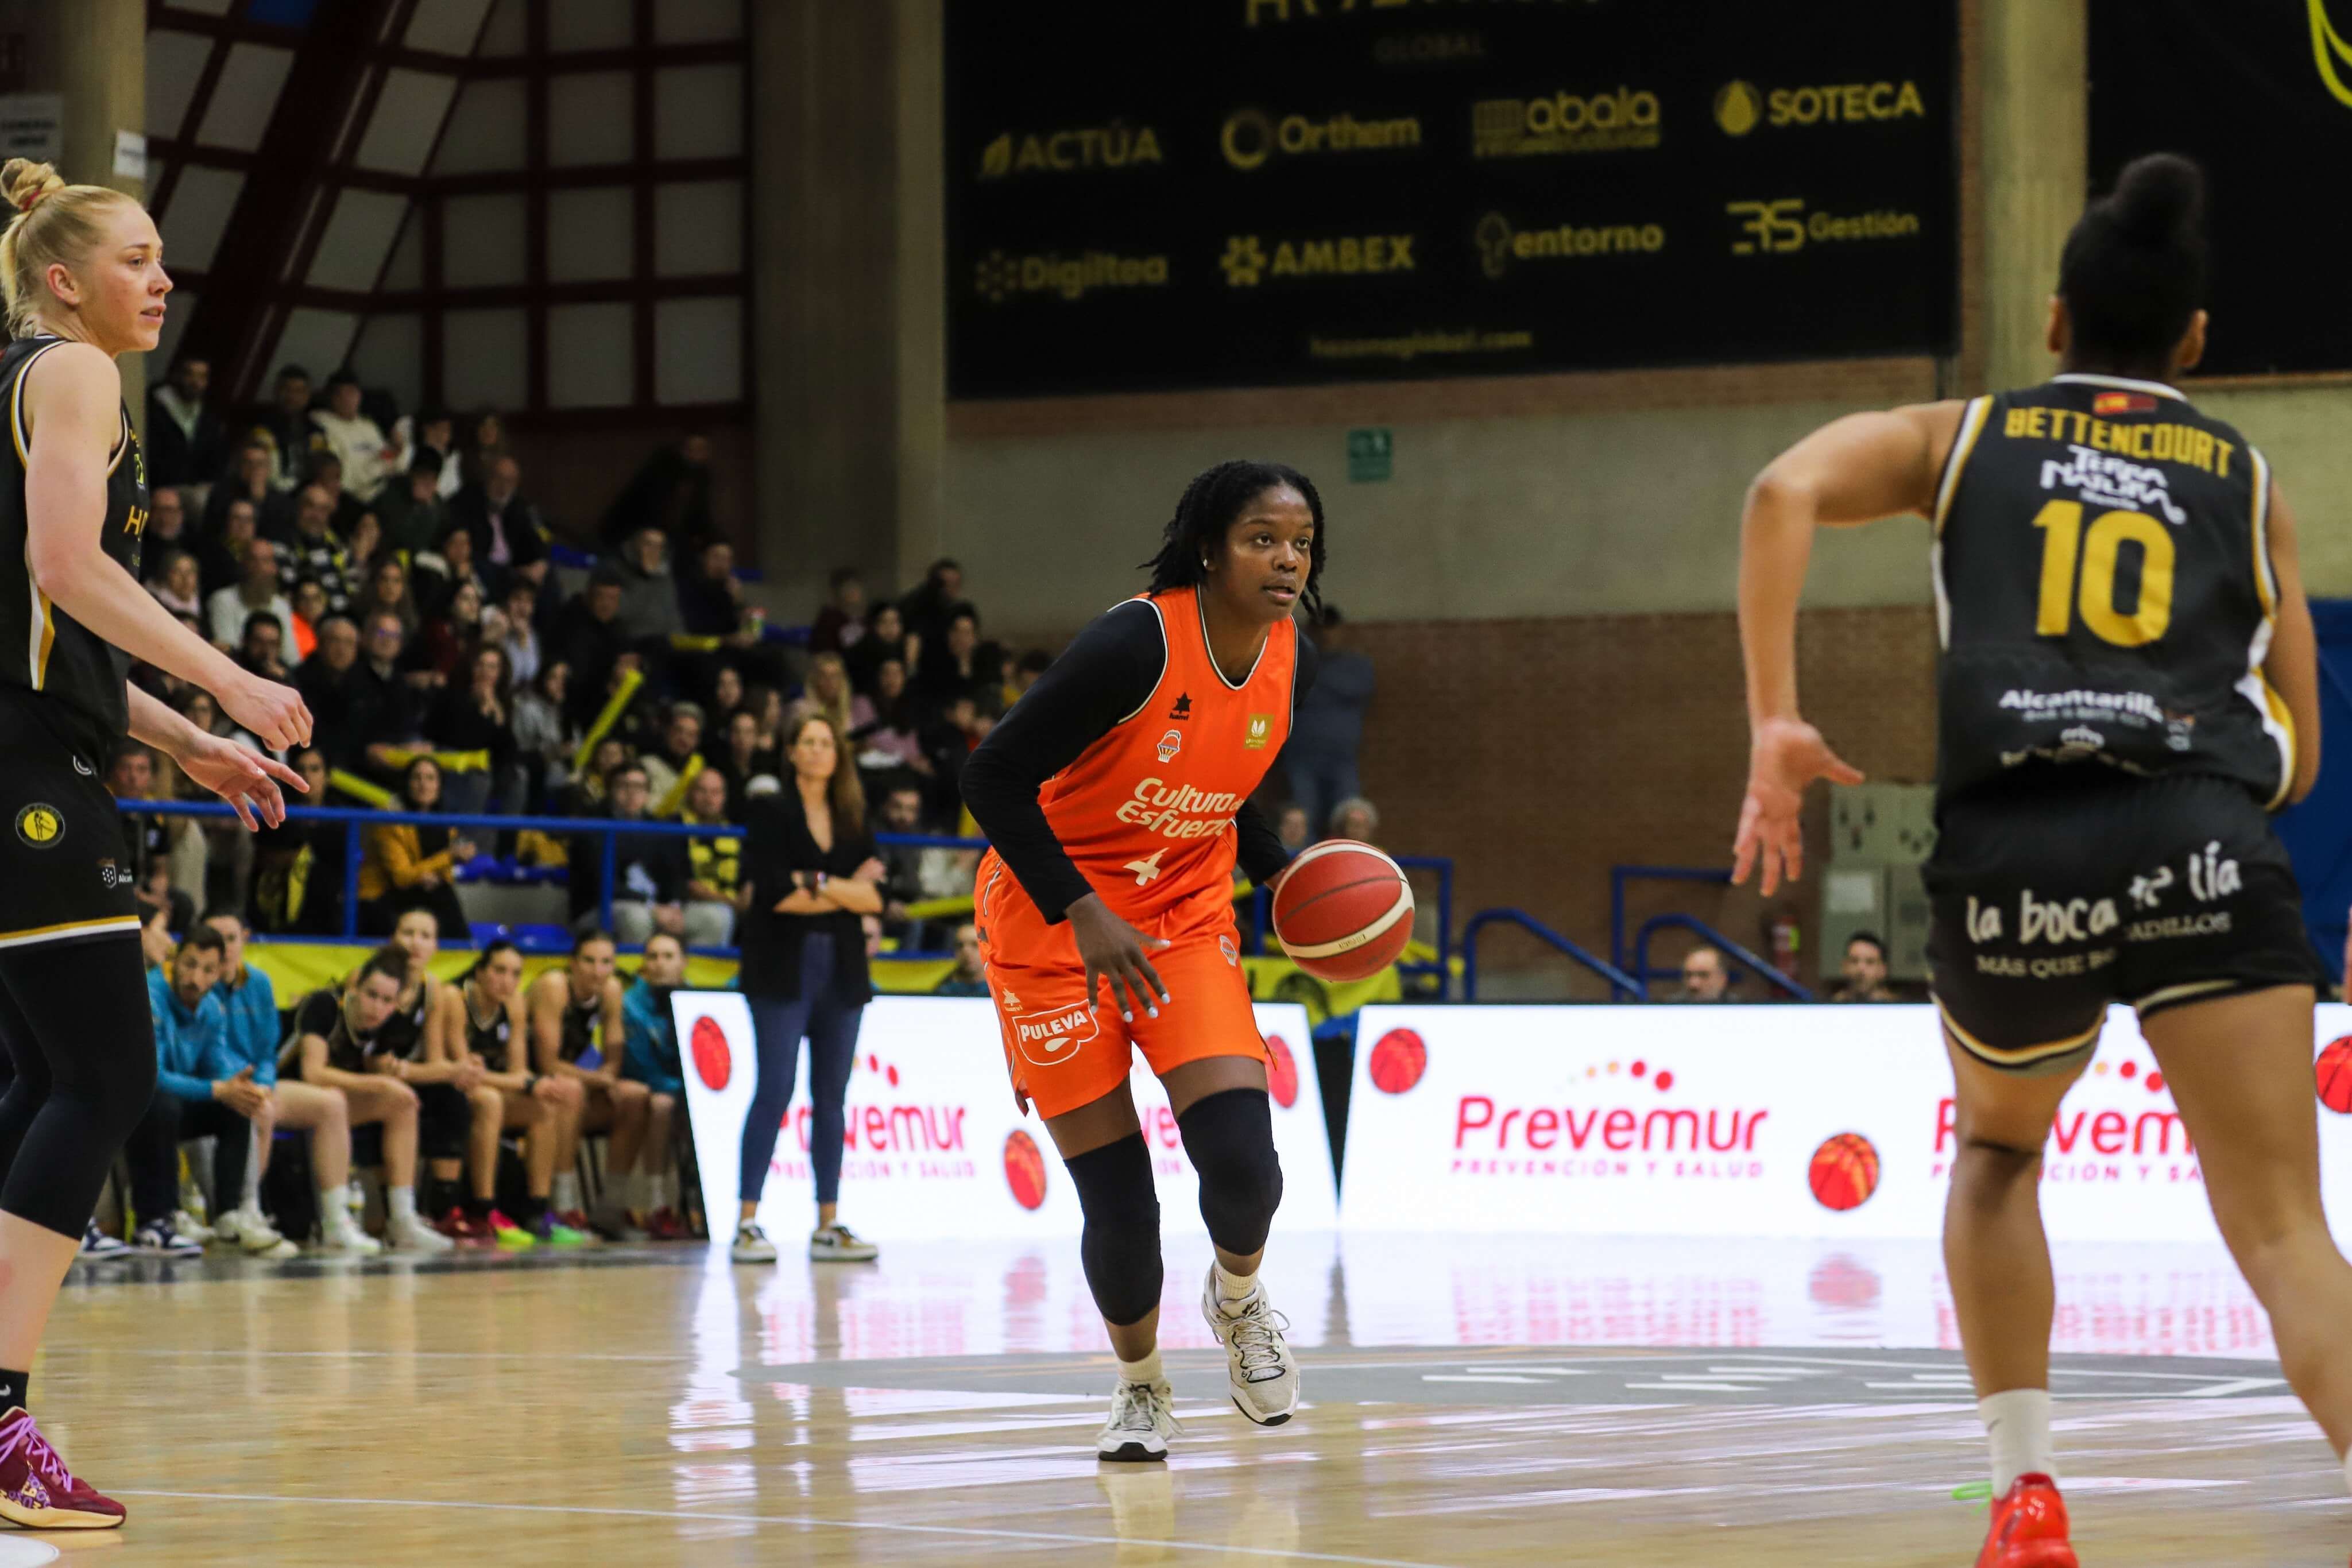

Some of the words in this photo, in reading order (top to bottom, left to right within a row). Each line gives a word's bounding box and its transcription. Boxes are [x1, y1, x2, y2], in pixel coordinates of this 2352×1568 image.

[1526, 85, 1661, 133] abala
[1769, 82, 1925, 125] SOTECA
[1015, 117, 1163, 171] ACTÚA
[1512, 224, 1665, 259] entorno
[1809, 210, 1920, 241] Gestión
[1272, 237, 1414, 274] AMBEX
[2005, 406, 2235, 479] BETTENCOURT
[2032, 498, 2176, 648] 10
[1134, 778, 1236, 813] Cultura
[1966, 895, 2003, 945] la
[2018, 888, 2120, 945] boca
[2030, 953, 2086, 980] QUE
[1020, 1010, 1088, 1042] PULEVA
[1455, 1095, 1769, 1152] Prevemur
[1646, 1160, 1659, 1177] Y
[1674, 1160, 1765, 1178] SALUD
[2138, 1165, 2151, 1182] Y
